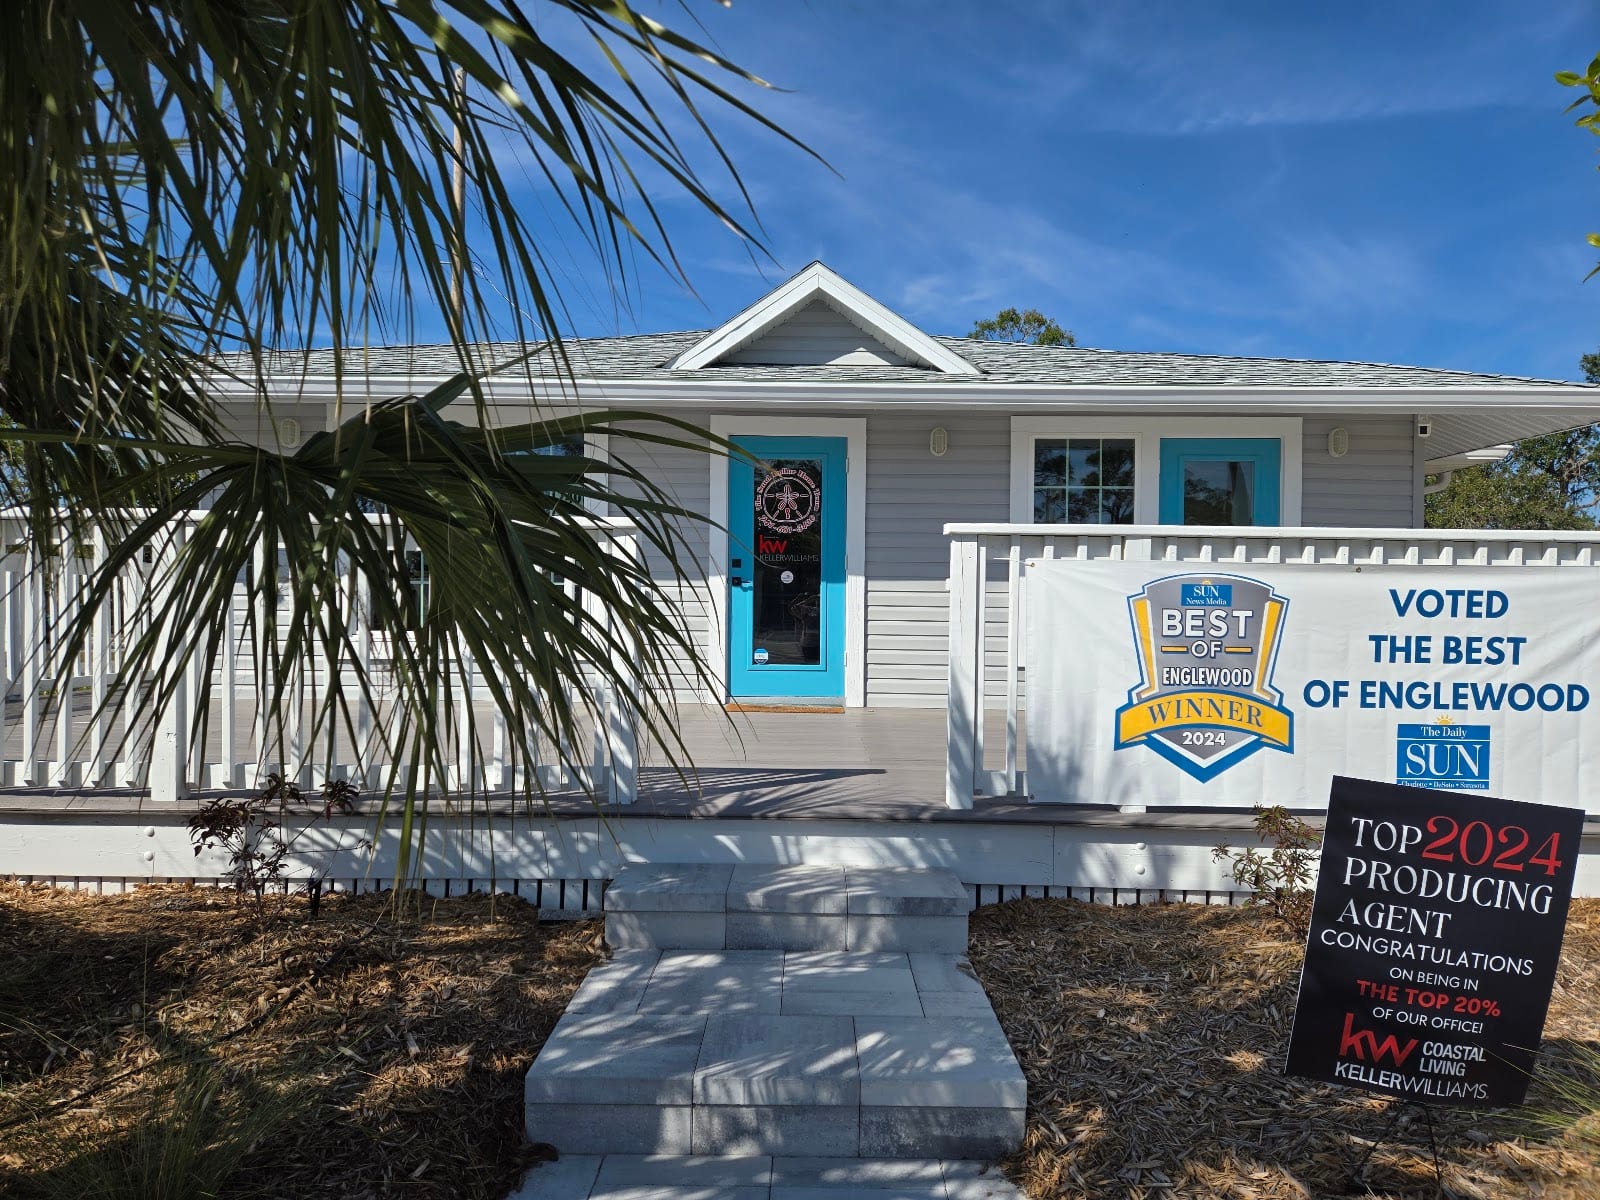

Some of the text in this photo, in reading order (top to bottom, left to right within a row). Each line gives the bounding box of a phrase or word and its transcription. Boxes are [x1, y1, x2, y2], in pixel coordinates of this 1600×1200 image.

[759, 535, 787, 554] kw
[1186, 597, 1227, 605] News Media
[1193, 586, 1219, 597] SUN
[1389, 588, 1509, 618] VOTED
[1162, 608, 1253, 638] BEST
[1191, 641, 1222, 658] OF
[1368, 634, 1527, 666] THE BEST
[1162, 667, 1254, 687] ENGLEWOOD
[1303, 680, 1590, 712] OF ENGLEWOOD
[1147, 697, 1263, 727] WINNER
[1182, 732, 1226, 746] 2024
[1420, 726, 1468, 738] The Daily
[1406, 742, 1482, 777] SUN
[1351, 815, 1562, 876] TOP 2024
[1343, 857, 1553, 915] PRODUCING
[1336, 898, 1452, 939] AGENT
[1320, 929, 1534, 976] CONGRATULATIONS
[1389, 967, 1479, 991] ON BEING IN
[1356, 979, 1501, 1017] THE TOP 20%
[1372, 1007, 1483, 1034] OF OUR OFFICE!
[1338, 1012, 1419, 1067] kw
[1422, 1040, 1487, 1062] COASTAL
[1334, 1062, 1489, 1099] KELLERWILLIAMS
[1419, 1057, 1466, 1077] LIVING
